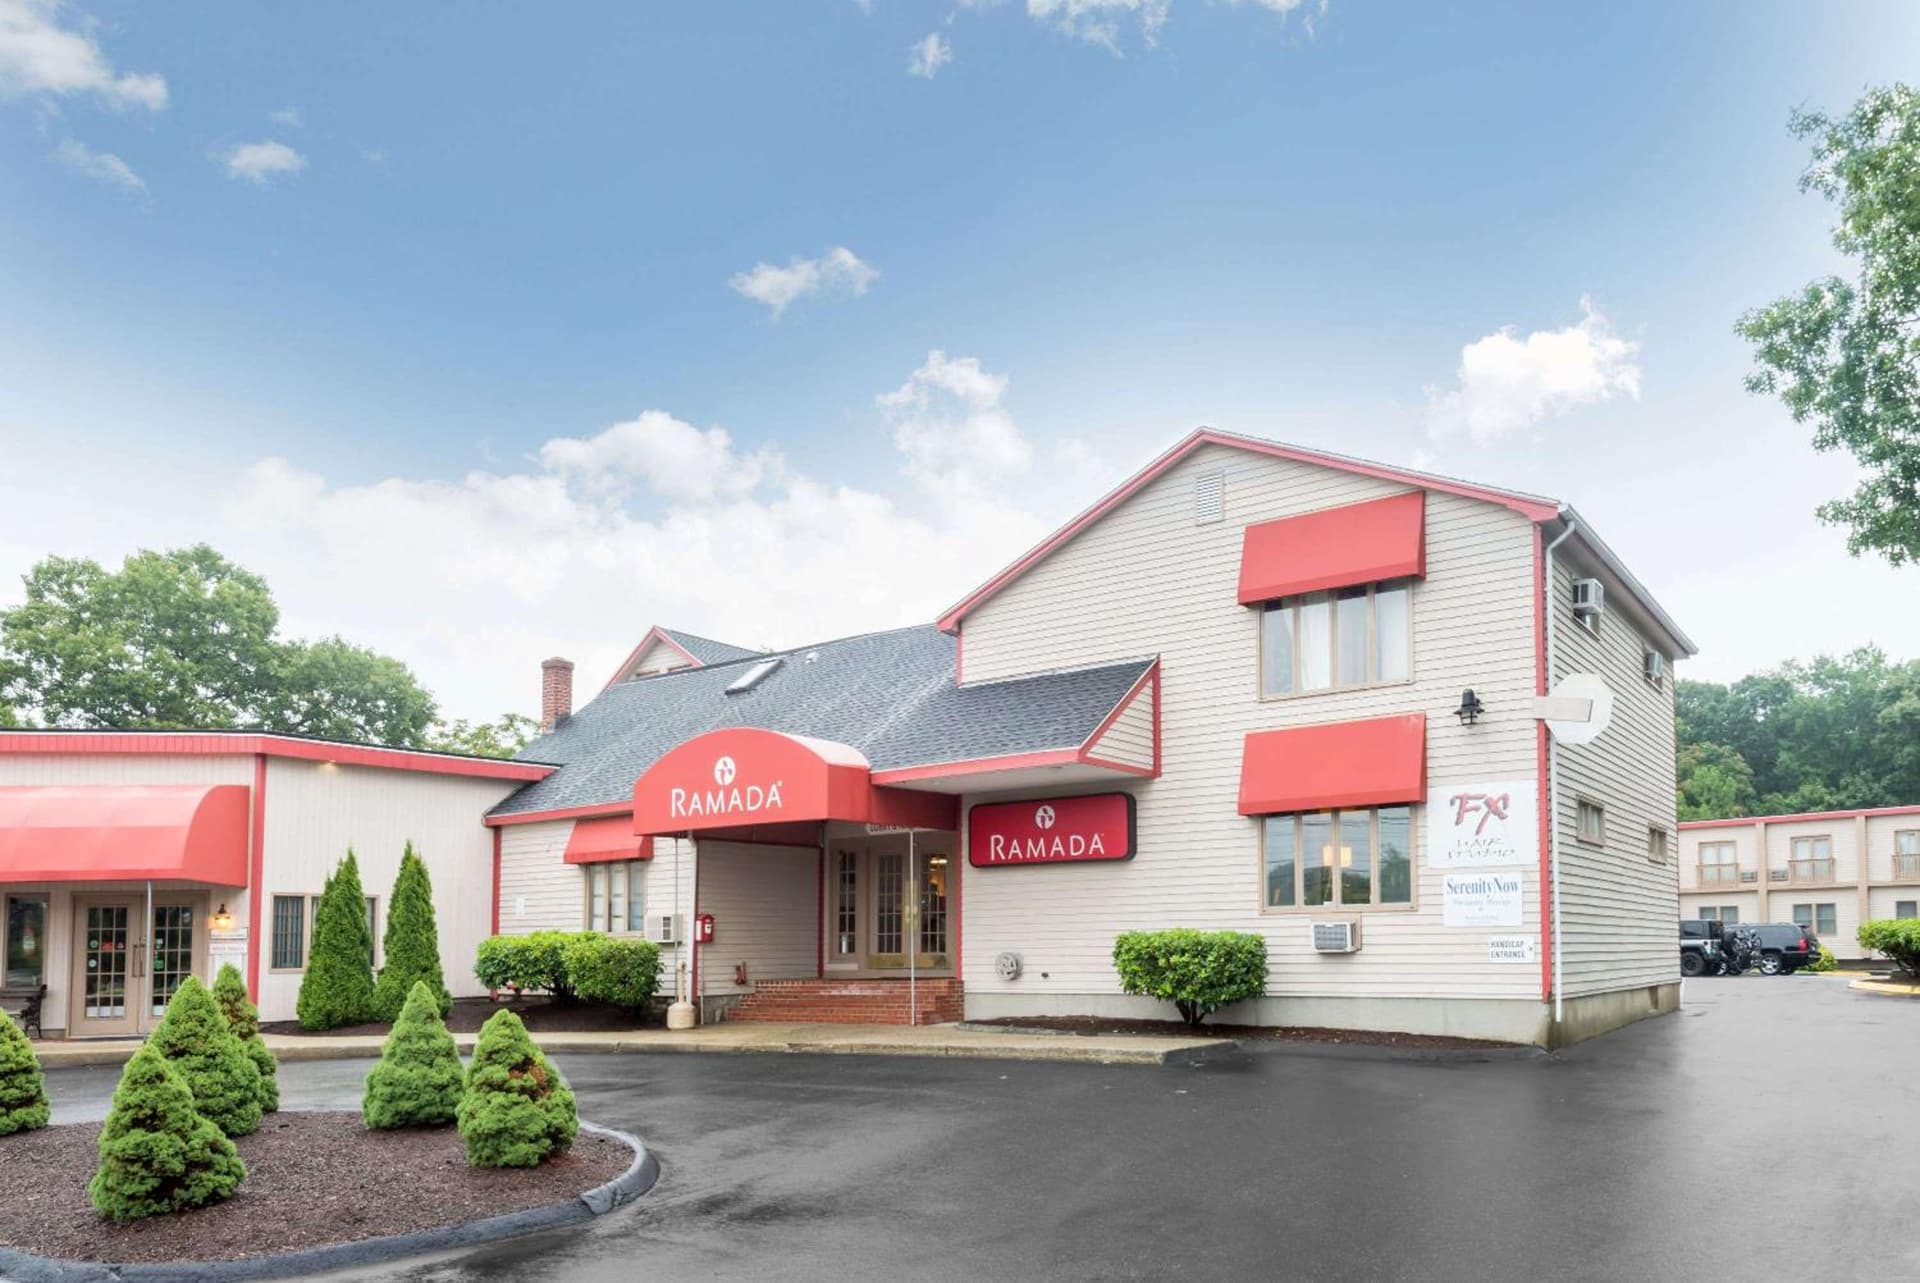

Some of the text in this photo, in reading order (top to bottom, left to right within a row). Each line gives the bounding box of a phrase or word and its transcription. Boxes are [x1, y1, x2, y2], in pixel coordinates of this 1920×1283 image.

[671, 783, 783, 818] RAMADA
[990, 833, 1105, 861] RAMADA
[1446, 876, 1519, 899] Serenity Now
[1490, 940, 1524, 949] HANDICAP
[1490, 950, 1526, 959] ENTRANCE
